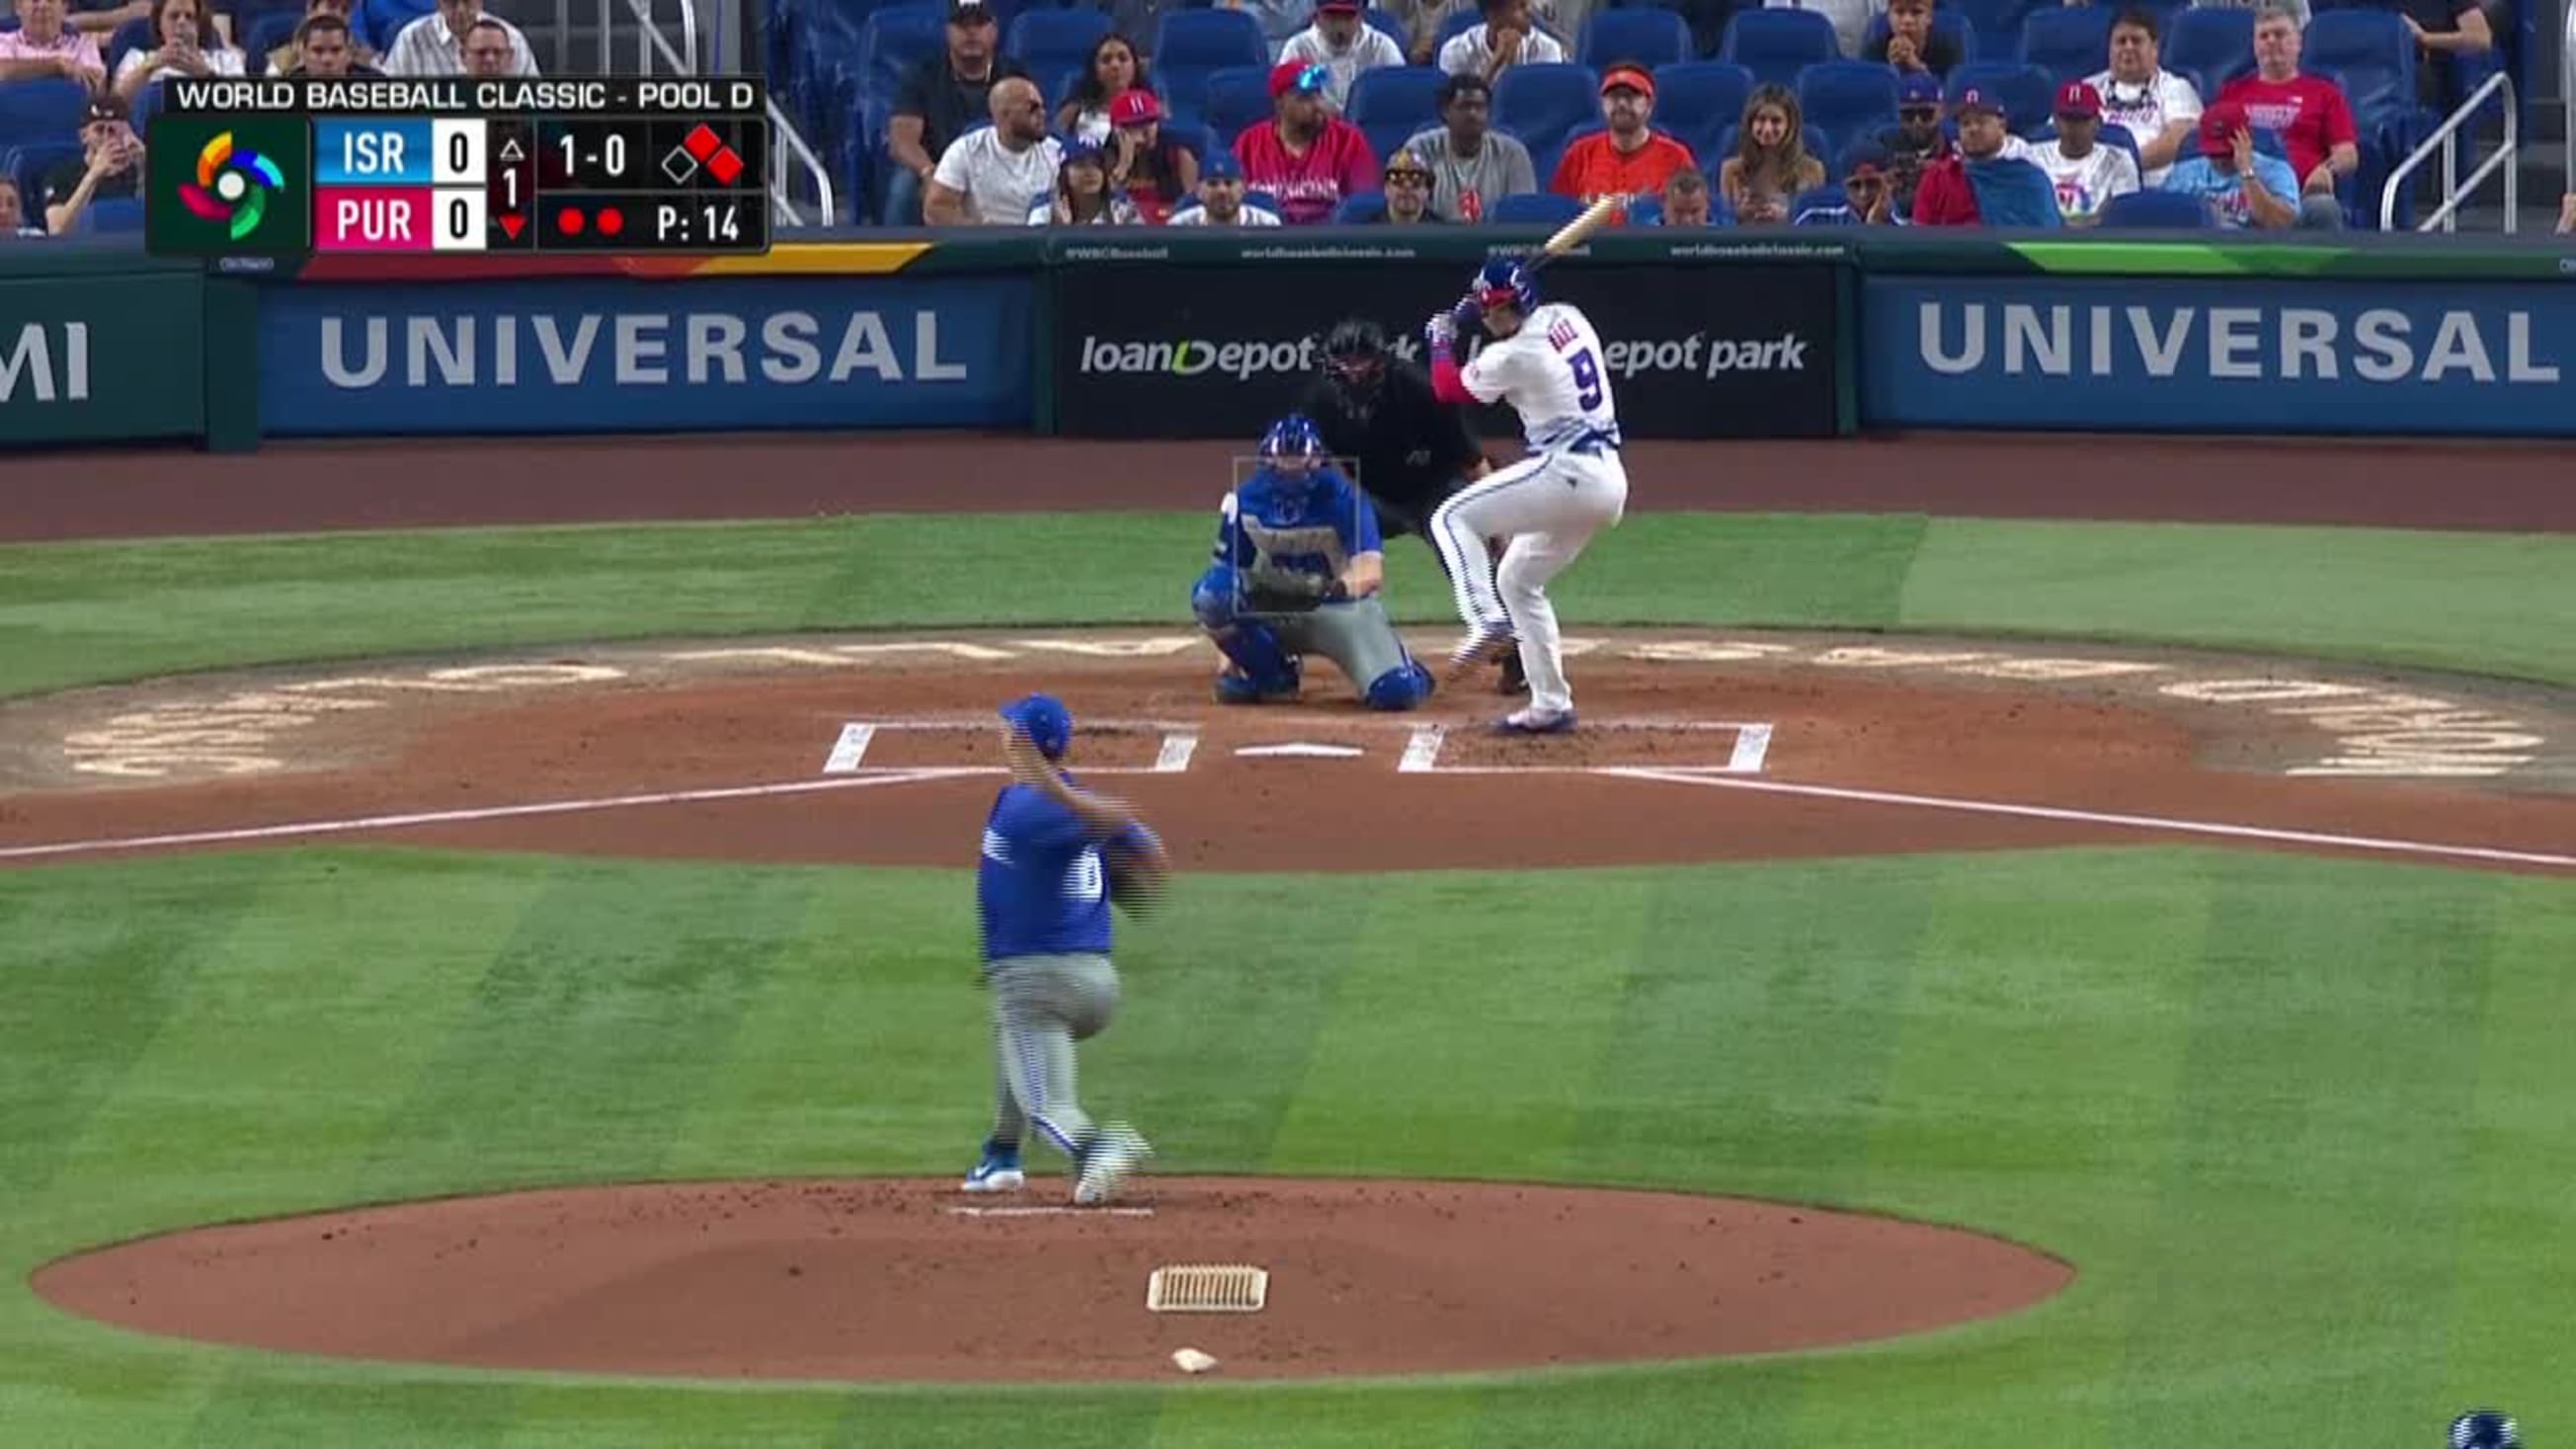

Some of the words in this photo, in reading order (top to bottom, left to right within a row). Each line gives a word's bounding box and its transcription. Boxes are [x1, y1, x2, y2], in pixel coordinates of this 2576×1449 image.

[321, 310, 967, 388] UNIVERSAL
[1080, 335, 1316, 380] loanDepot
[1705, 332, 1808, 379] park
[1919, 301, 2560, 382] UNIVERSAL
[1566, 346, 1603, 413] 9
